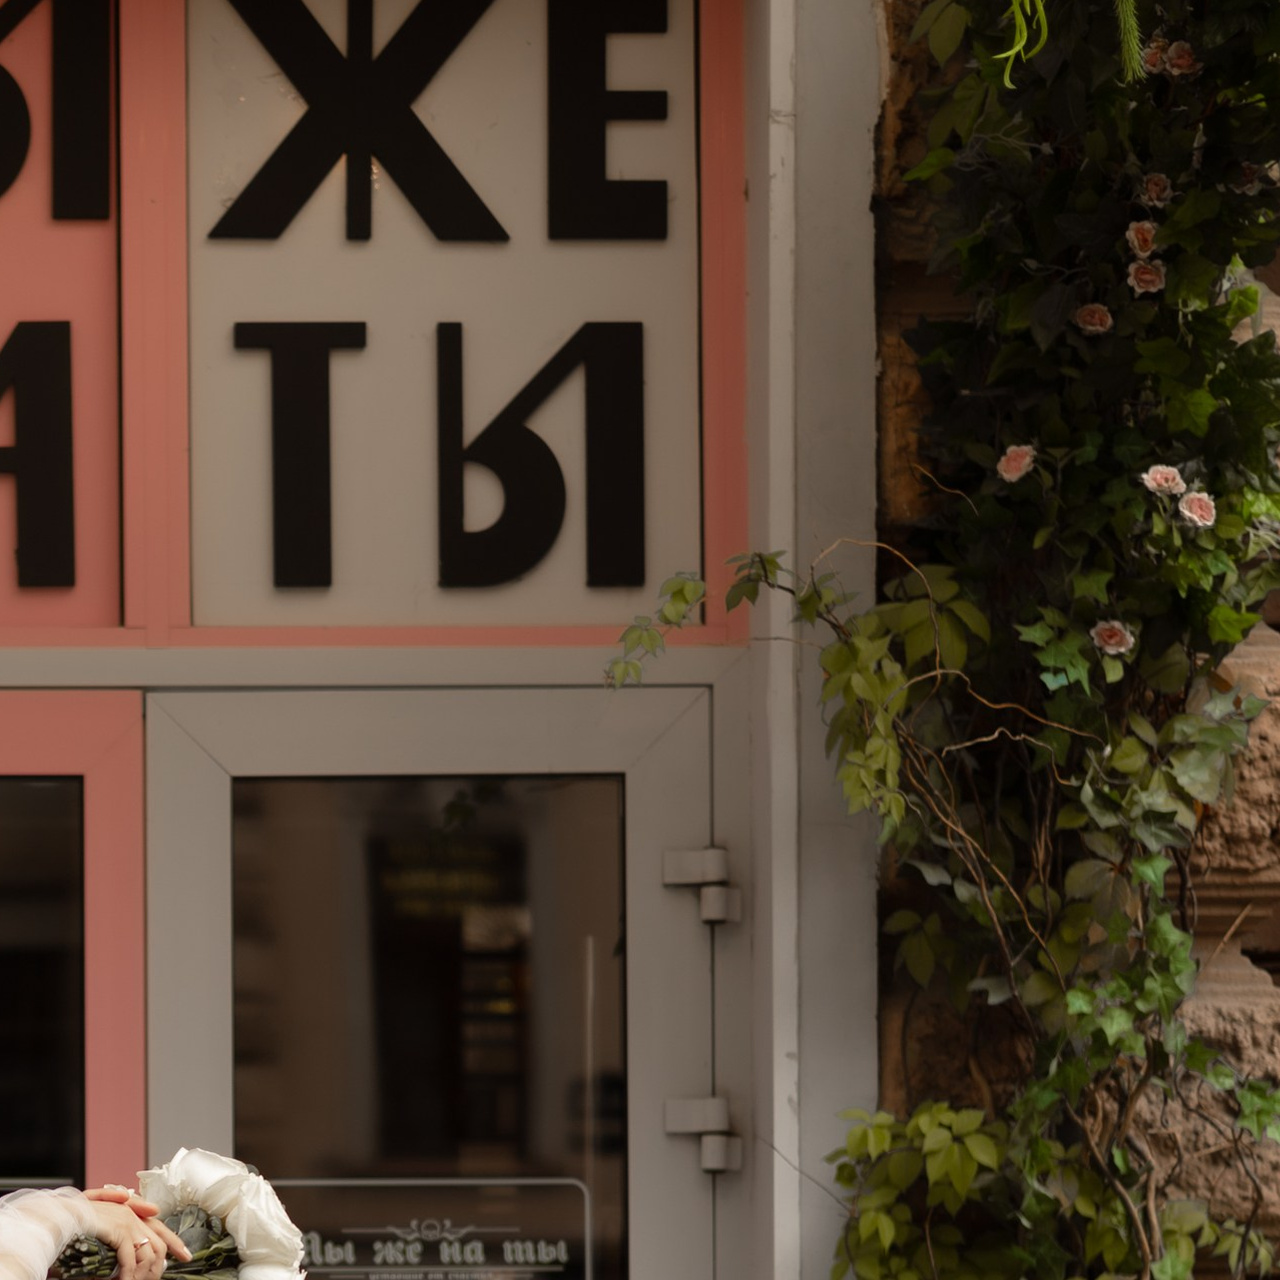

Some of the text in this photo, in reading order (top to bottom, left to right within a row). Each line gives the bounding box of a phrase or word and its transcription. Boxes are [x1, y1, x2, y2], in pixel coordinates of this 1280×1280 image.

[207, 0, 668, 241] ЖЕ
[233, 321, 645, 588] ТЫ
[373, 1239, 423, 1265] же
[440, 1239, 485, 1264] на
[503, 1239, 569, 1264] ты
